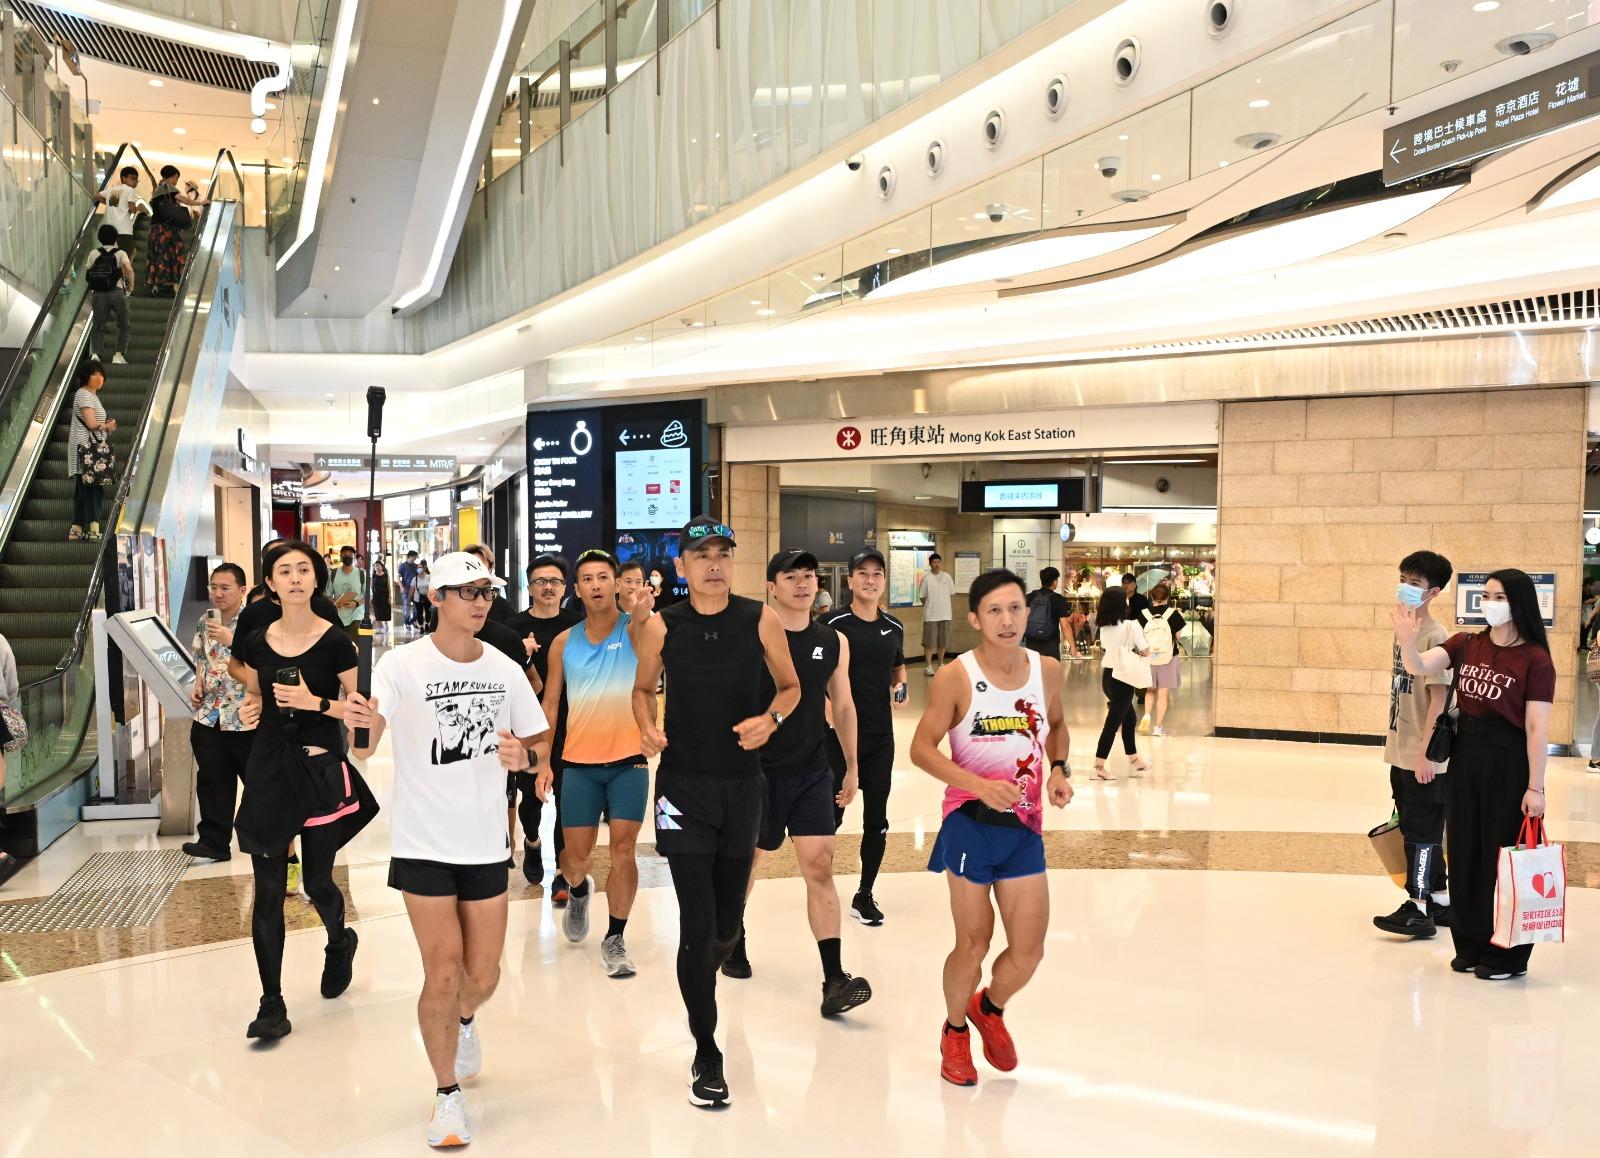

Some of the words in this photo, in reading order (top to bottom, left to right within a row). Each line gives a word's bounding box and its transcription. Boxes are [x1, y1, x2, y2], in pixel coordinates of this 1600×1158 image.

[1495, 90, 1540, 117] 帝京酒店
[1547, 98, 1566, 110] Flower
[1413, 109, 1487, 146] 跨境巴士候車處
[1495, 117, 1509, 128] Royal
[1510, 113, 1525, 122] Plaza
[870, 424, 945, 446] 旺角東站
[950, 432, 981, 445] Mong
[984, 429, 1005, 442] Kok
[1008, 429, 1031, 441] East
[1034, 427, 1076, 440] Station
[1459, 663, 1516, 689] ERFECT
[425, 681, 469, 697] STAMP
[982, 716, 1029, 732] THOMAS
